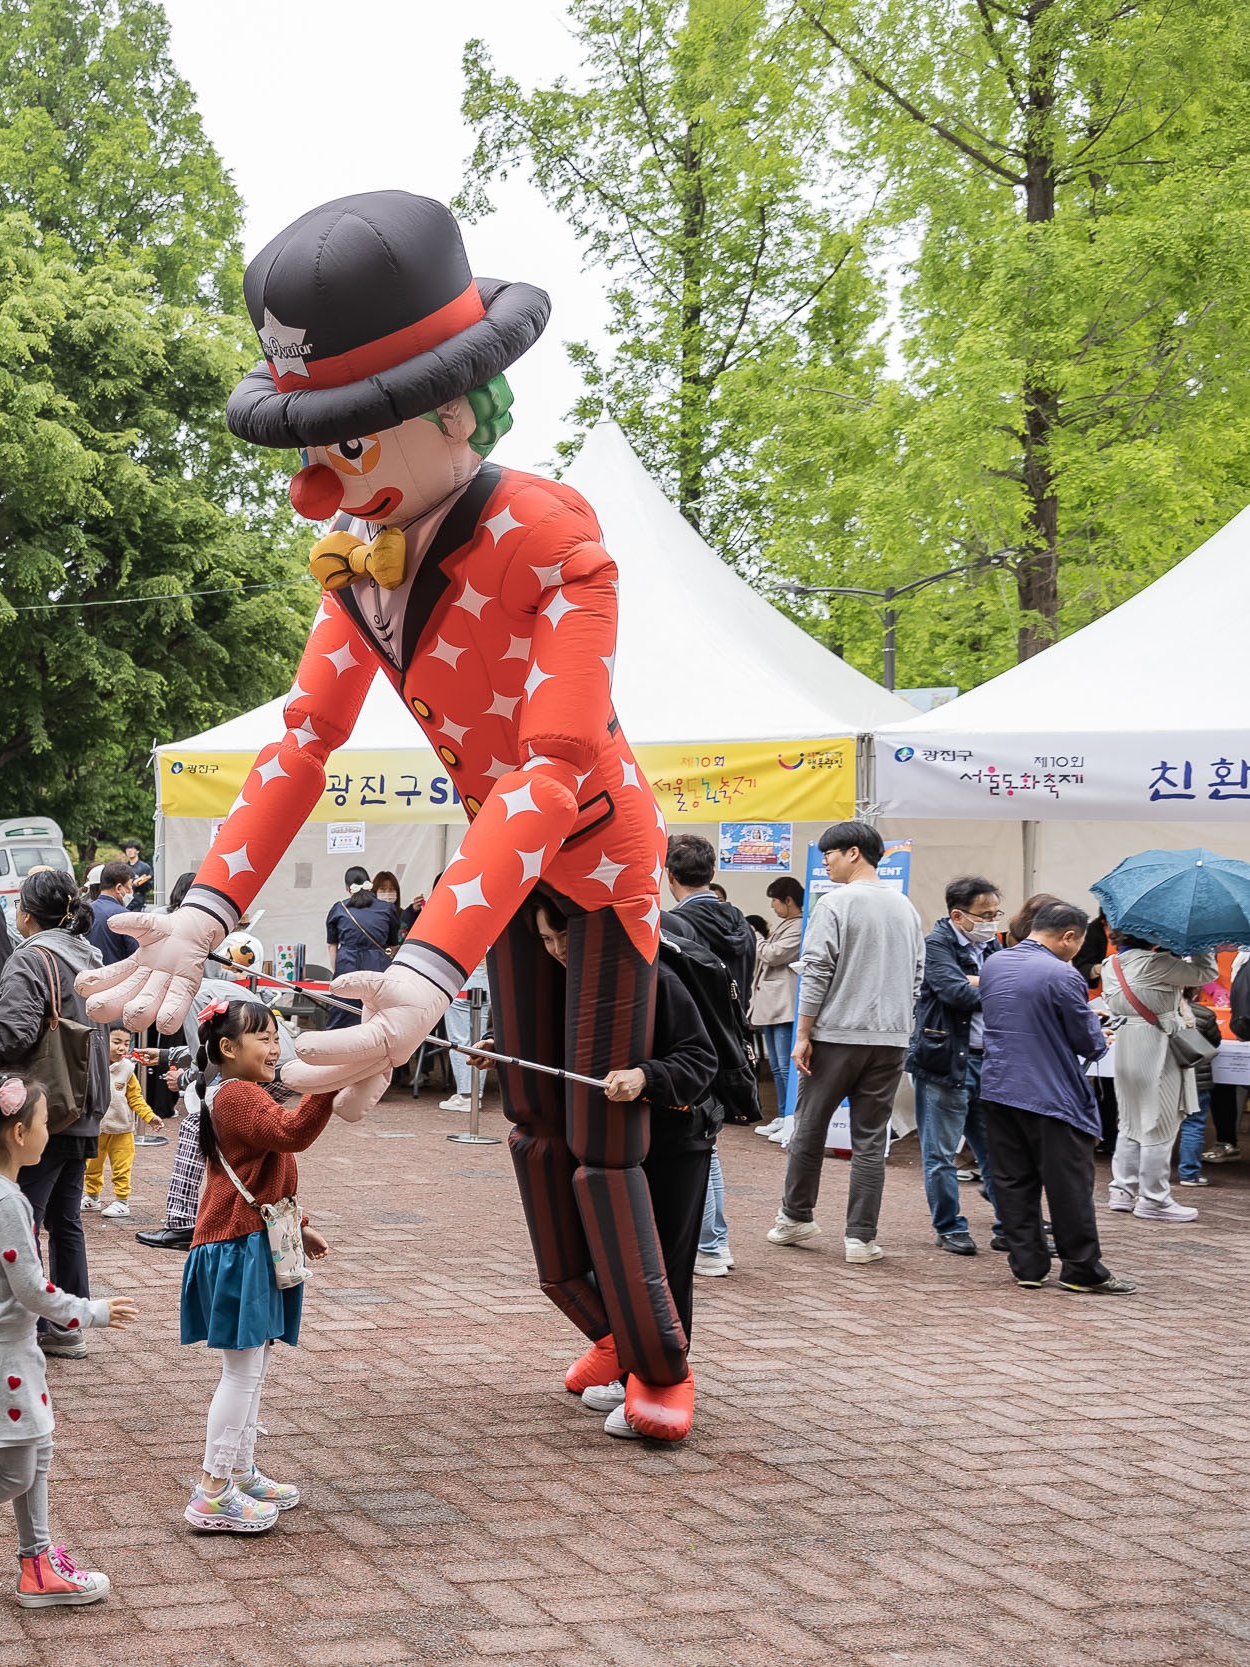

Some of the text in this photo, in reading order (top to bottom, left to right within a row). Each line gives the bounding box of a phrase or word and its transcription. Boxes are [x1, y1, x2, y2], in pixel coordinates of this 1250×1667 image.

[680, 755, 725, 768] 제10회
[921, 750, 974, 762] 광진구
[1034, 756, 1084, 768] 제10회
[186, 764, 219, 775] 광진구
[959, 766, 1084, 799] 서울동화축제
[874, 866, 903, 876] VENT
